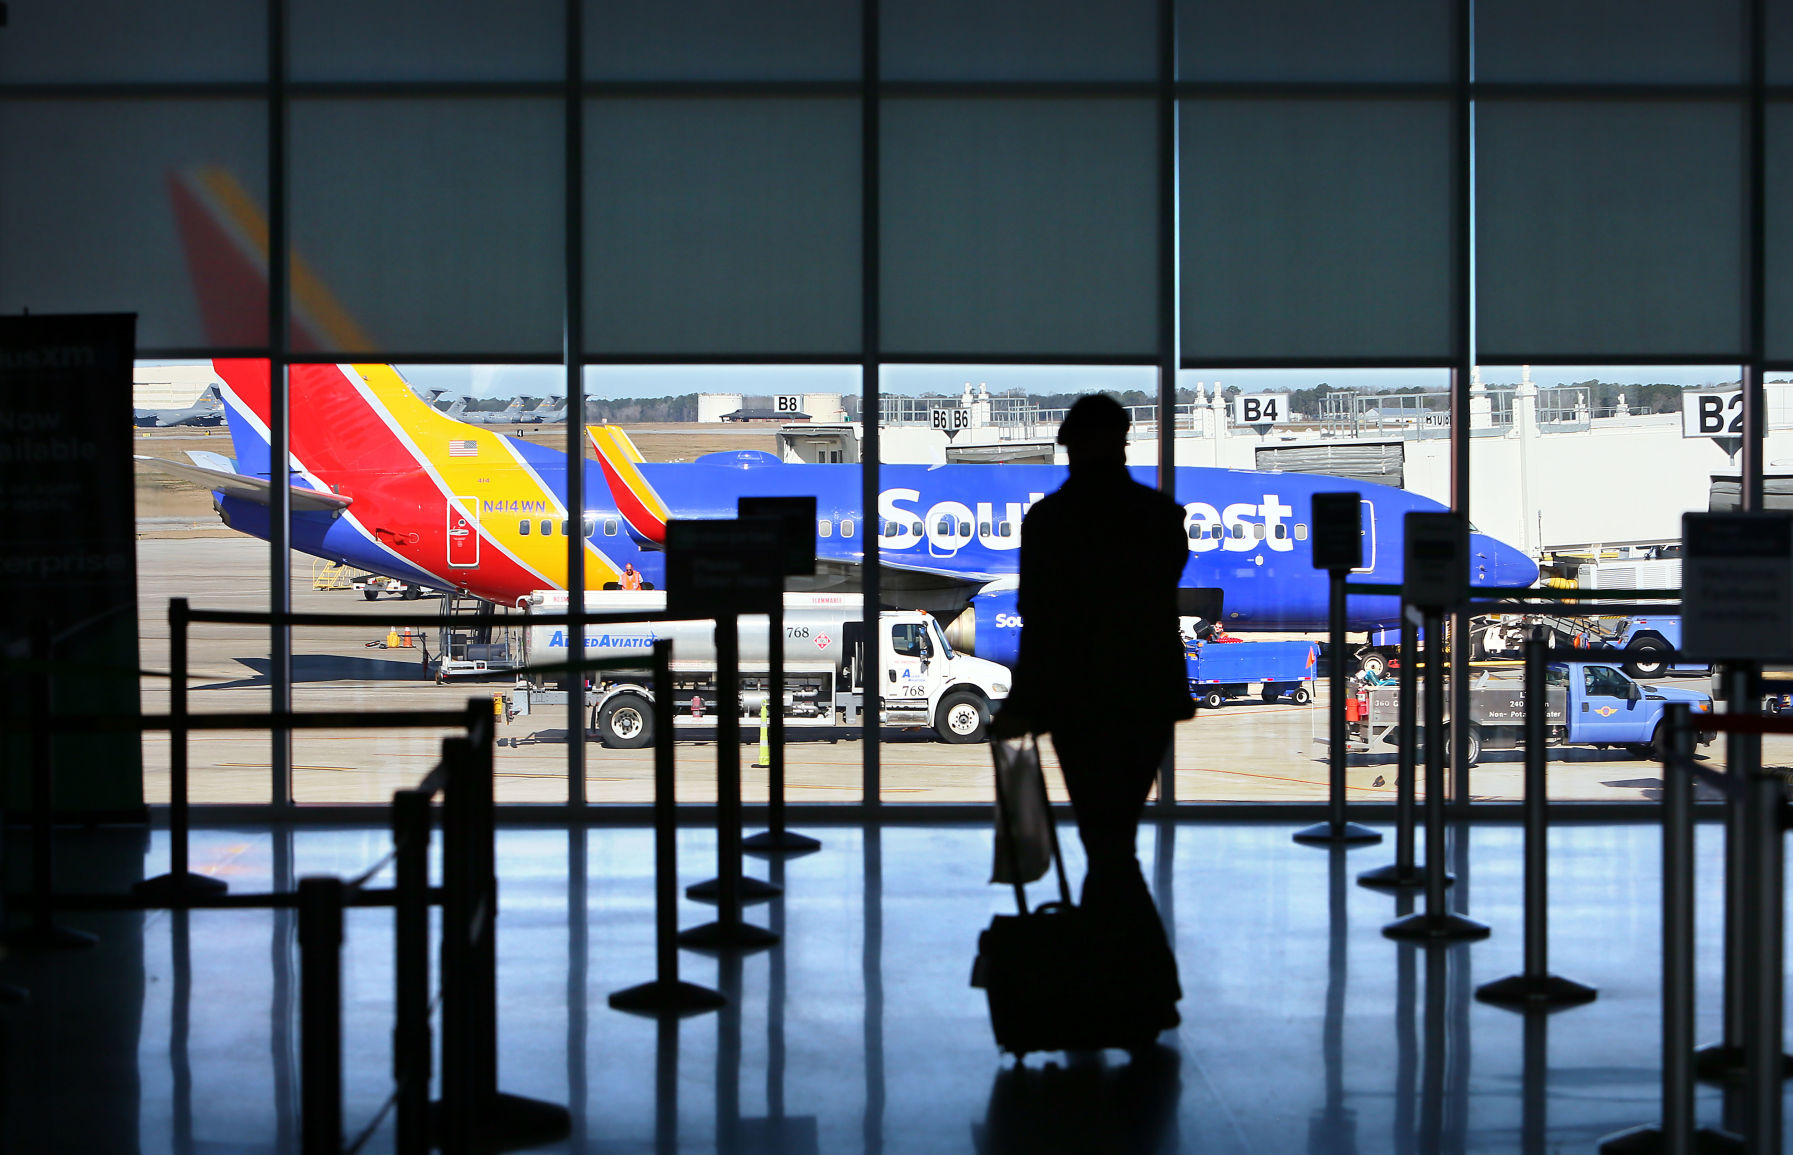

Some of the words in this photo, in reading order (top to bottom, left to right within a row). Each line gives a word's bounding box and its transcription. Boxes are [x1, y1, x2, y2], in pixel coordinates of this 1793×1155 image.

[778, 396, 797, 411] B8
[1243, 398, 1278, 422] B4
[933, 410, 947, 428] B6
[953, 410, 968, 428] B6
[1699, 393, 1743, 433] B2
[483, 500, 546, 512] N414WN
[786, 627, 810, 638] 768
[902, 685, 925, 697] 768
